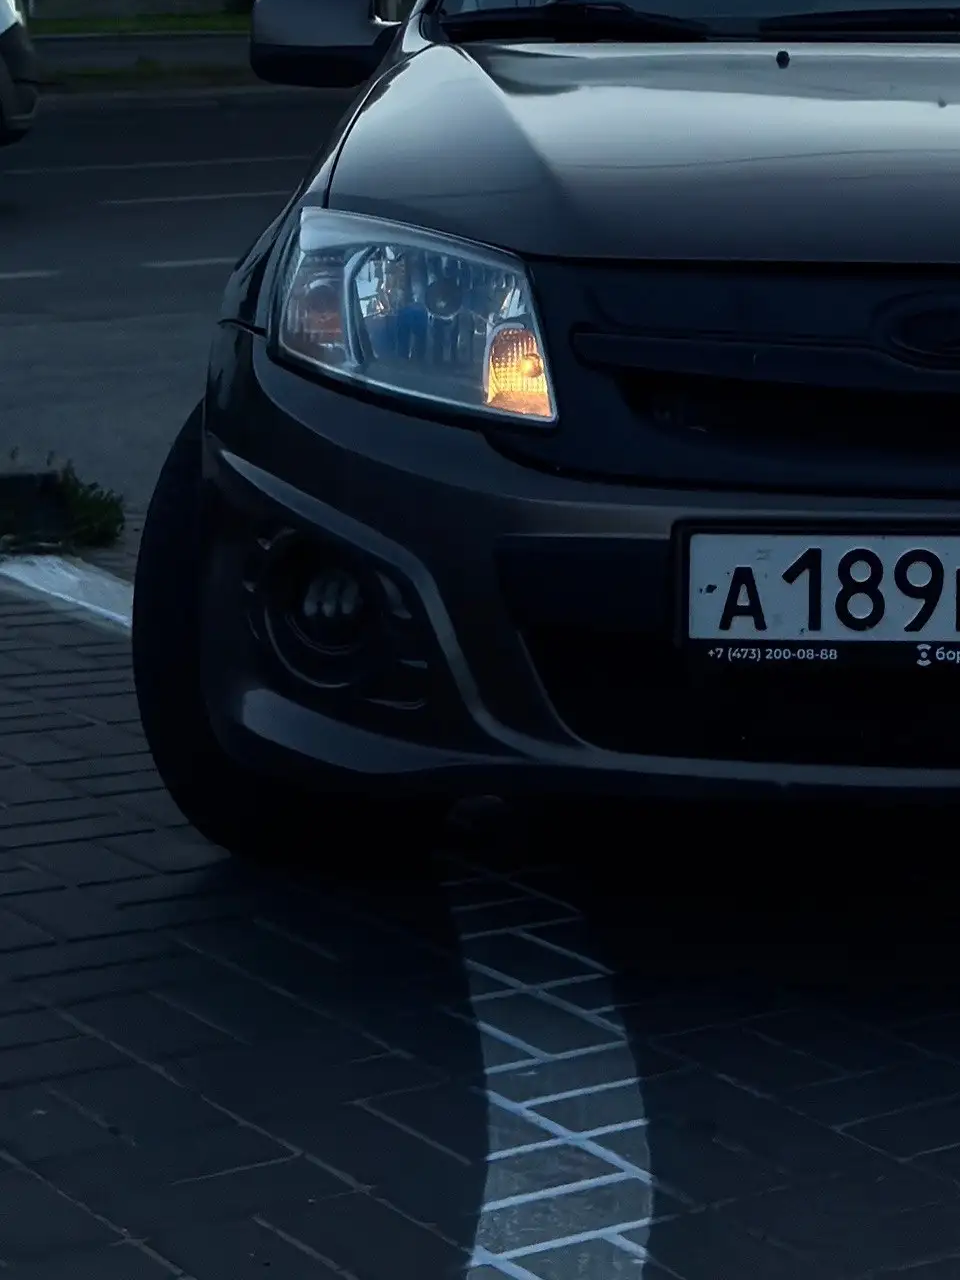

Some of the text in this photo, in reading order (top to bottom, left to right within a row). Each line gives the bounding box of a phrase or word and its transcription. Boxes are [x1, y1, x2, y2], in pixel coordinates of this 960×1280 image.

[707, 647, 838, 662] +7 (473) 200-08-88
